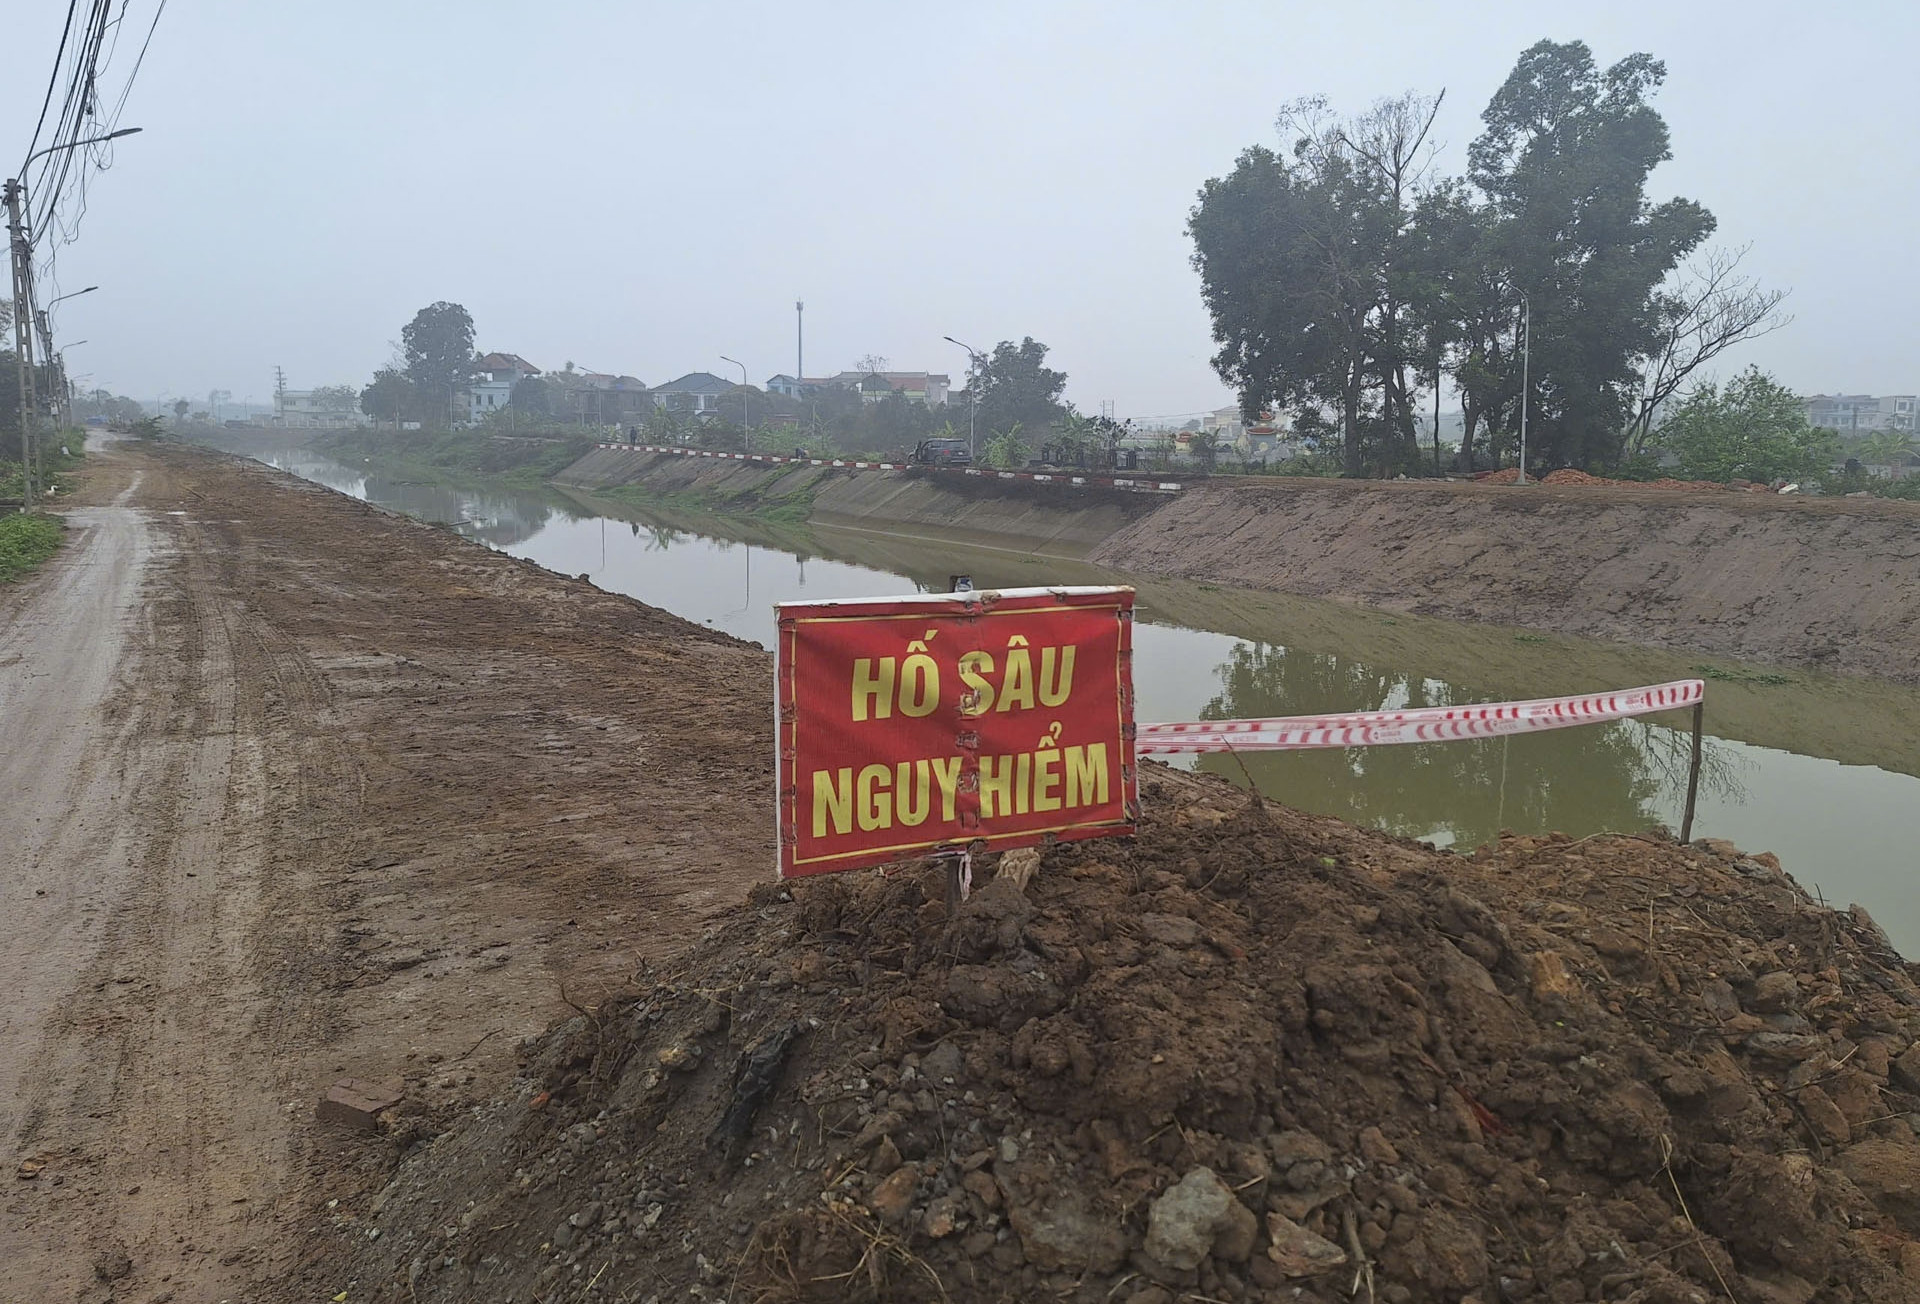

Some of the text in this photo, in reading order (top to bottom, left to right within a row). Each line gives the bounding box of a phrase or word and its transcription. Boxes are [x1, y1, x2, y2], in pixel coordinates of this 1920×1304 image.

[852, 629, 1076, 722] HỐ SÂU
[812, 721, 1109, 838] NGUY HIỂM
